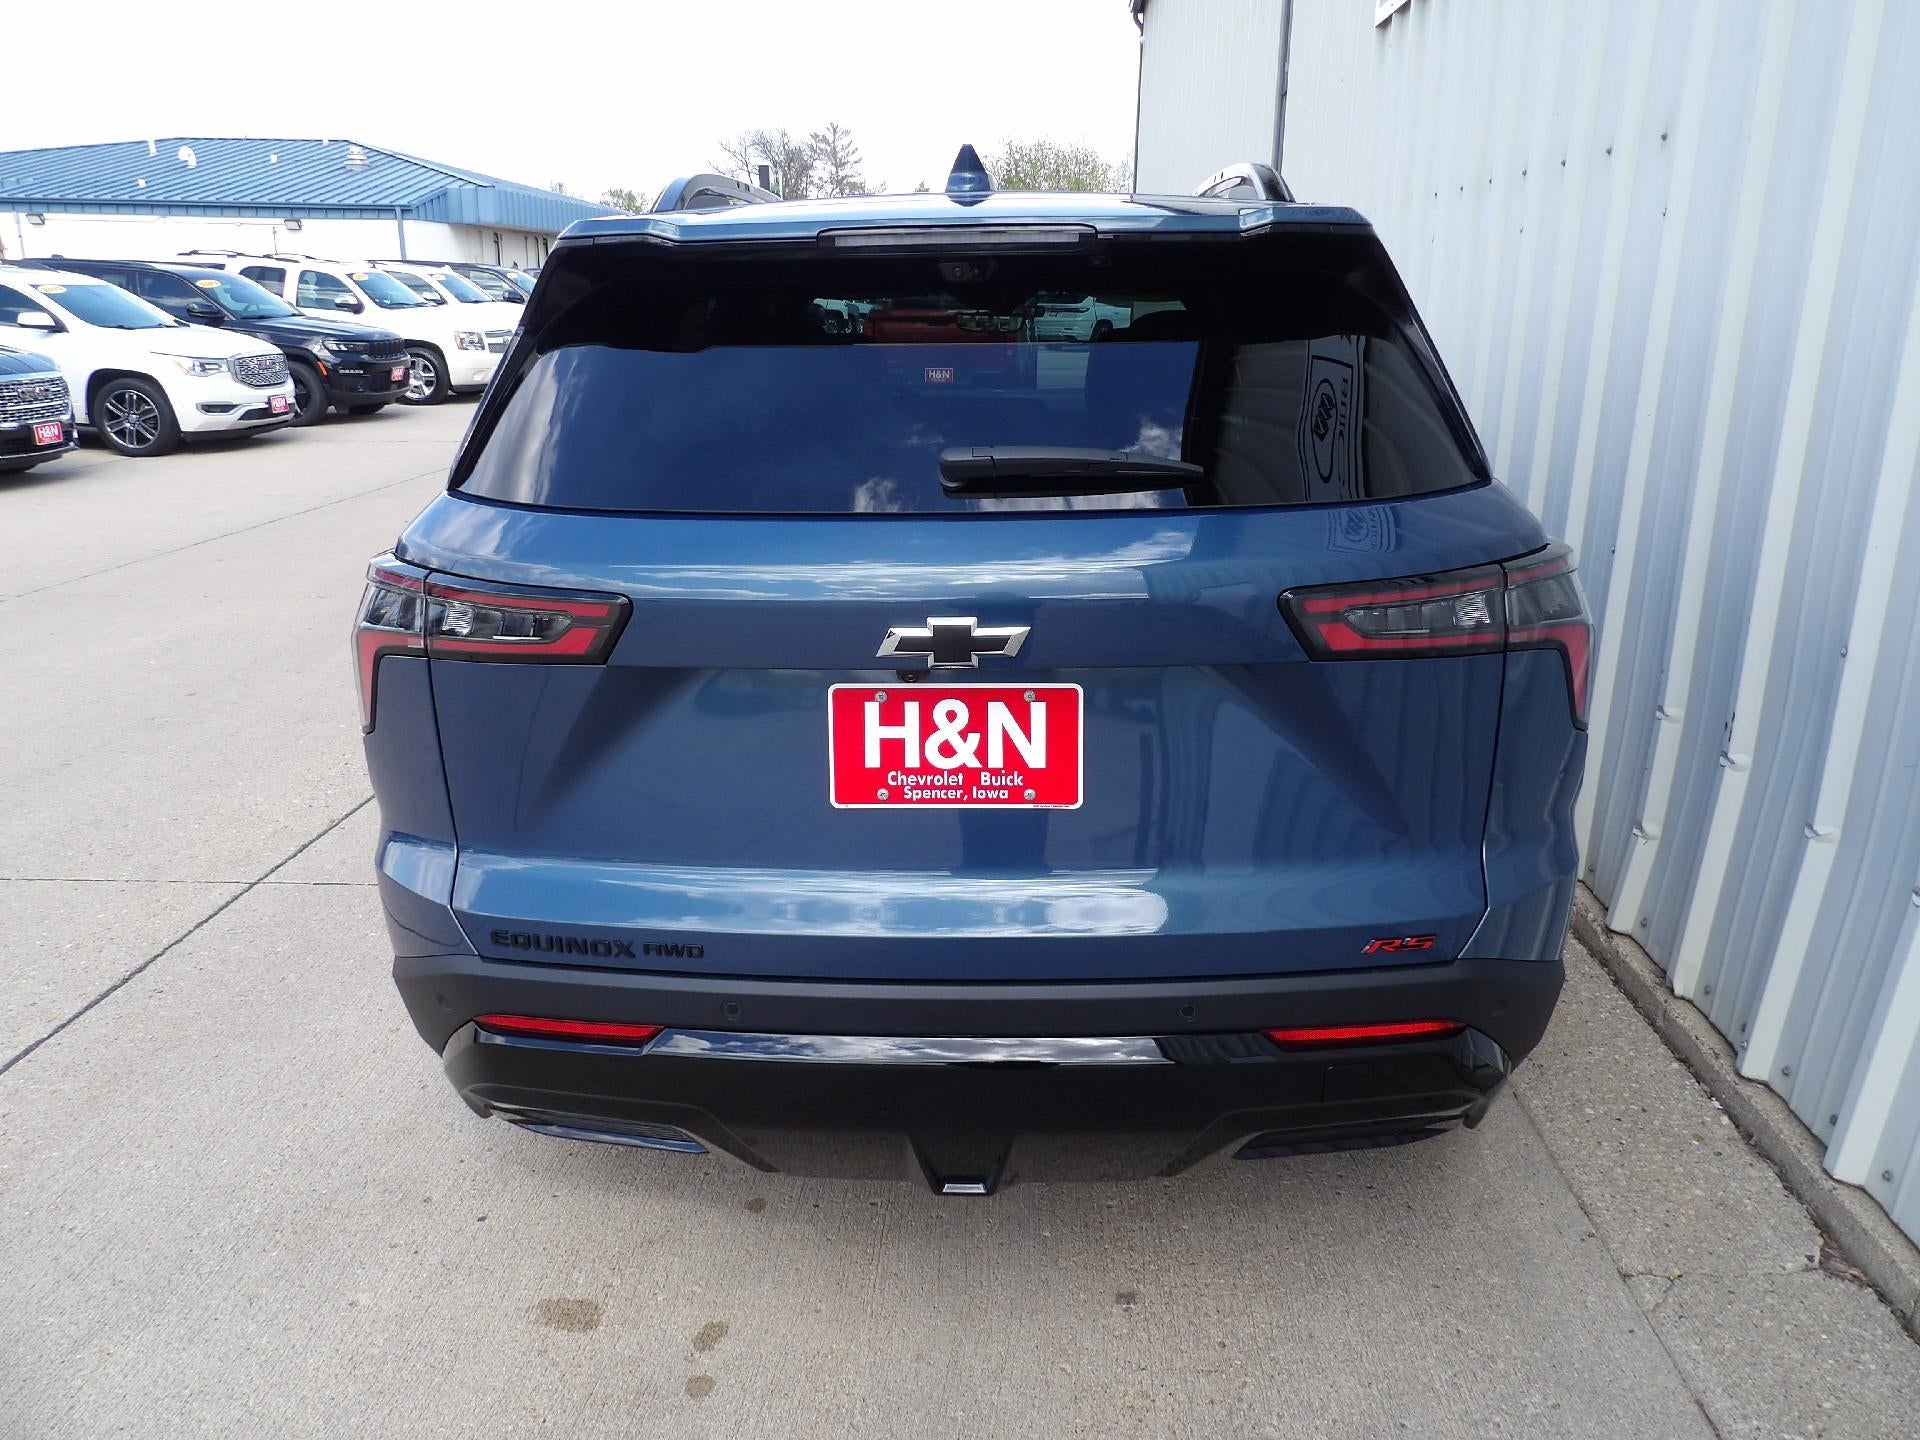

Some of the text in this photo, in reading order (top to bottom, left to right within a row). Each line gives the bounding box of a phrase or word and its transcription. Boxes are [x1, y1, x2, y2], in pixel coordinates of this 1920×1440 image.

[929, 370, 950, 379] H&N
[37, 424, 59, 439] H&N
[863, 698, 1047, 770] H&N
[887, 770, 1024, 786] Chevrolet Buick
[903, 786, 1009, 802] Spencer, Iowa
[490, 929, 705, 959] EQUINOX AWD
[1360, 934, 1437, 954] RS
